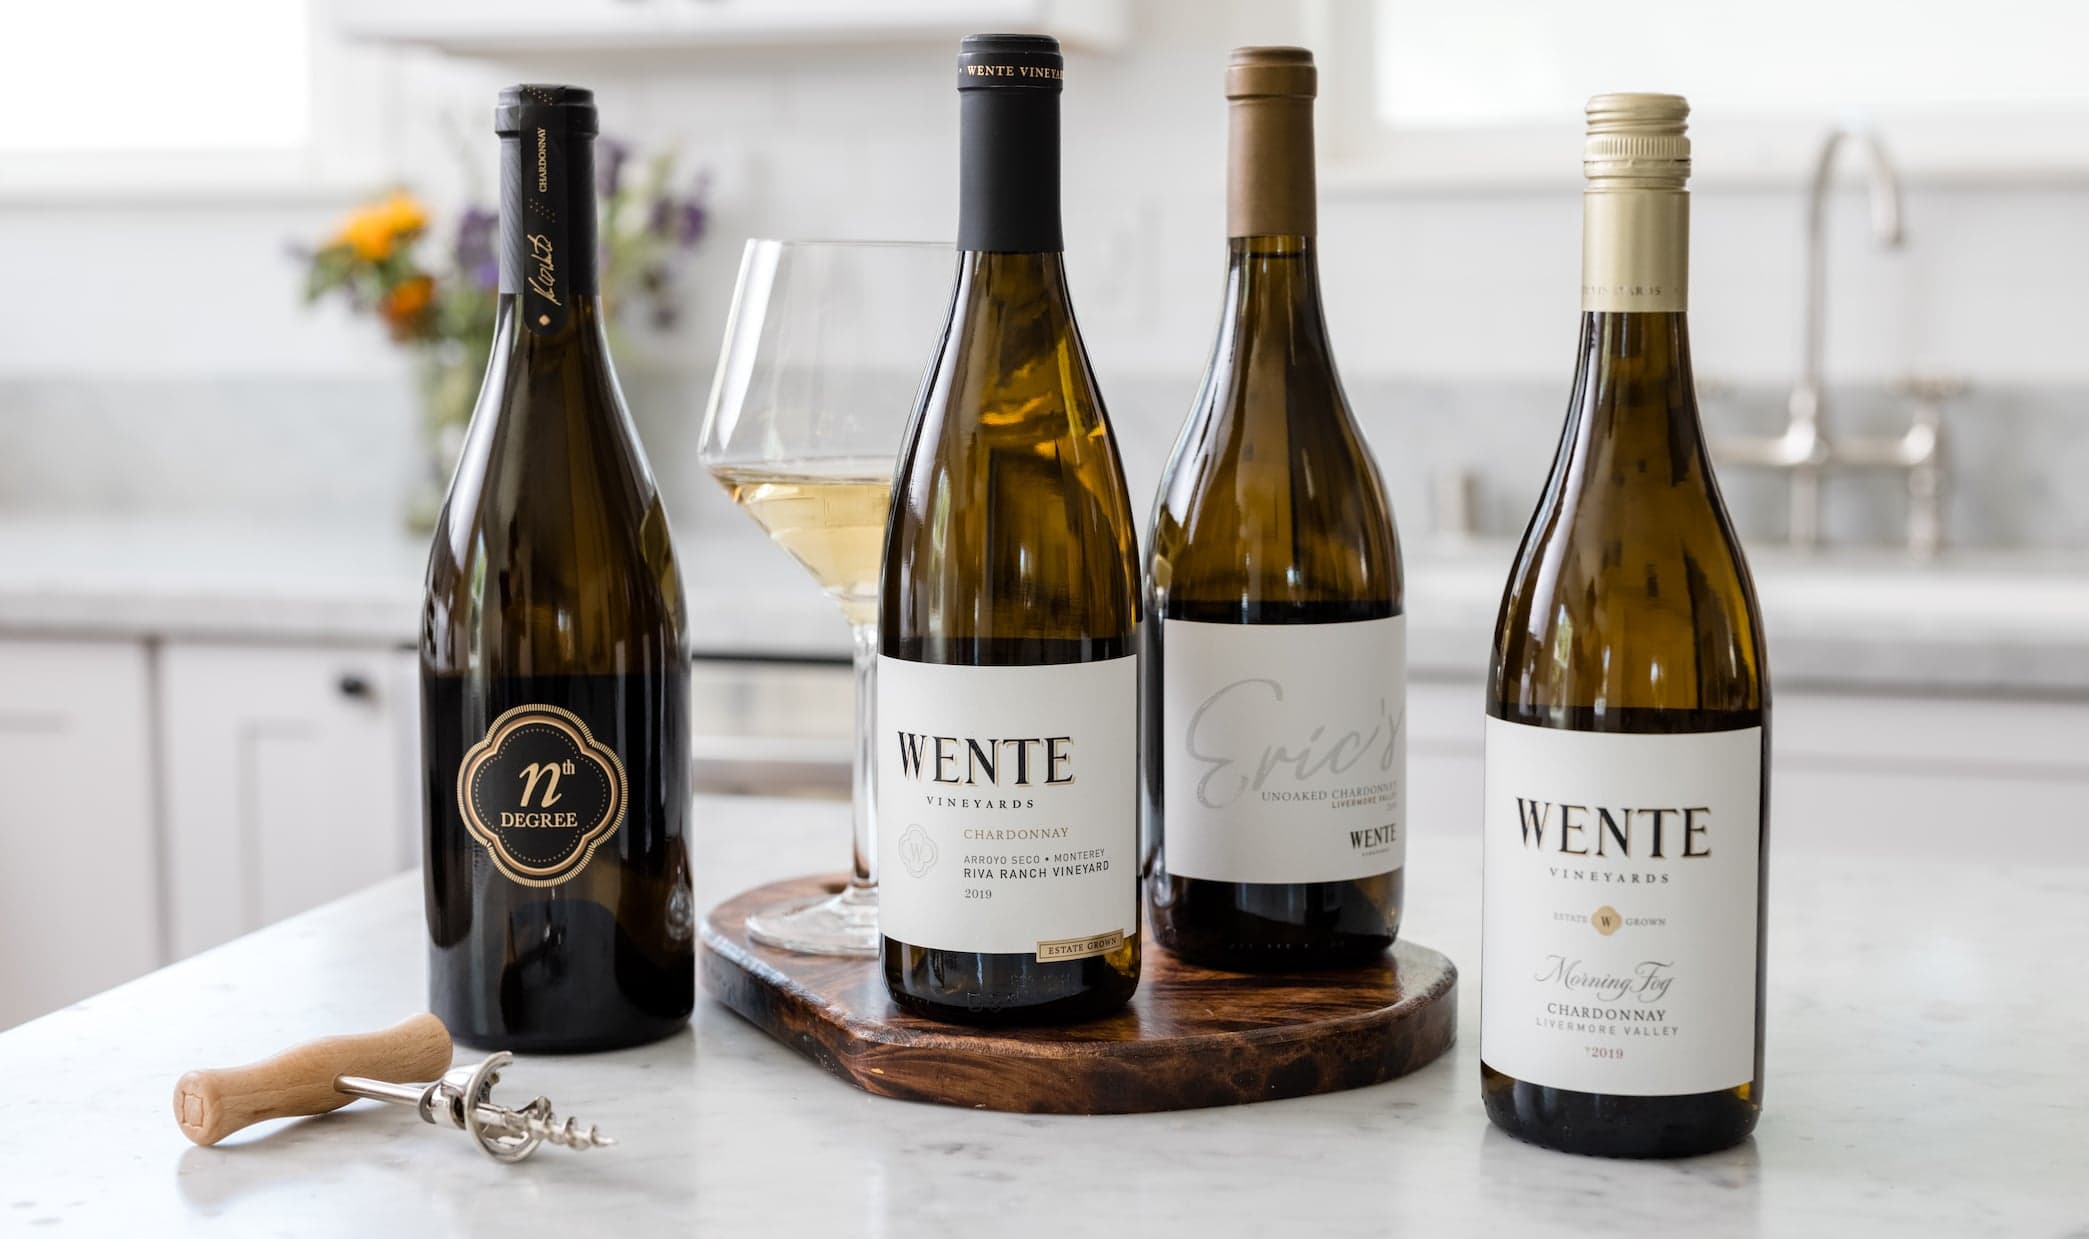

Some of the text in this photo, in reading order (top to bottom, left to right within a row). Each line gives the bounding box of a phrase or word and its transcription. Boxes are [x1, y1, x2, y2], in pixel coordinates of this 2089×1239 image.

[967, 65, 1015, 77] WENTE
[538, 127, 548, 193] CHARDONNAY
[1185, 677, 1402, 809] Eric's
[897, 731, 1076, 787] WENTE
[926, 795, 1035, 809] VINEYARDS
[1261, 791, 1328, 802] UNOAKED
[500, 812, 578, 828] DEGREE
[1516, 796, 1713, 859] WENTE
[963, 827, 1069, 840] CHARDONNAY
[1350, 823, 1397, 850] WENTE
[963, 848, 1105, 865] ARROYO SECO MONTEREY
[963, 860, 1110, 879] RIVA RANCH VINEYARD
[1549, 867, 1671, 885] VINEYARDS
[963, 888, 992, 899] 2019
[1553, 911, 1666, 928] ESTATE W GROWN
[1047, 937, 1118, 955] ESTATE GROWN
[1534, 954, 1675, 1004] Morning Fog
[1547, 1002, 1667, 1022] CHARDONNAY
[1535, 1016, 1679, 1037] LIVERMORE VALLEY
[1591, 1047, 1624, 1060] 2019
